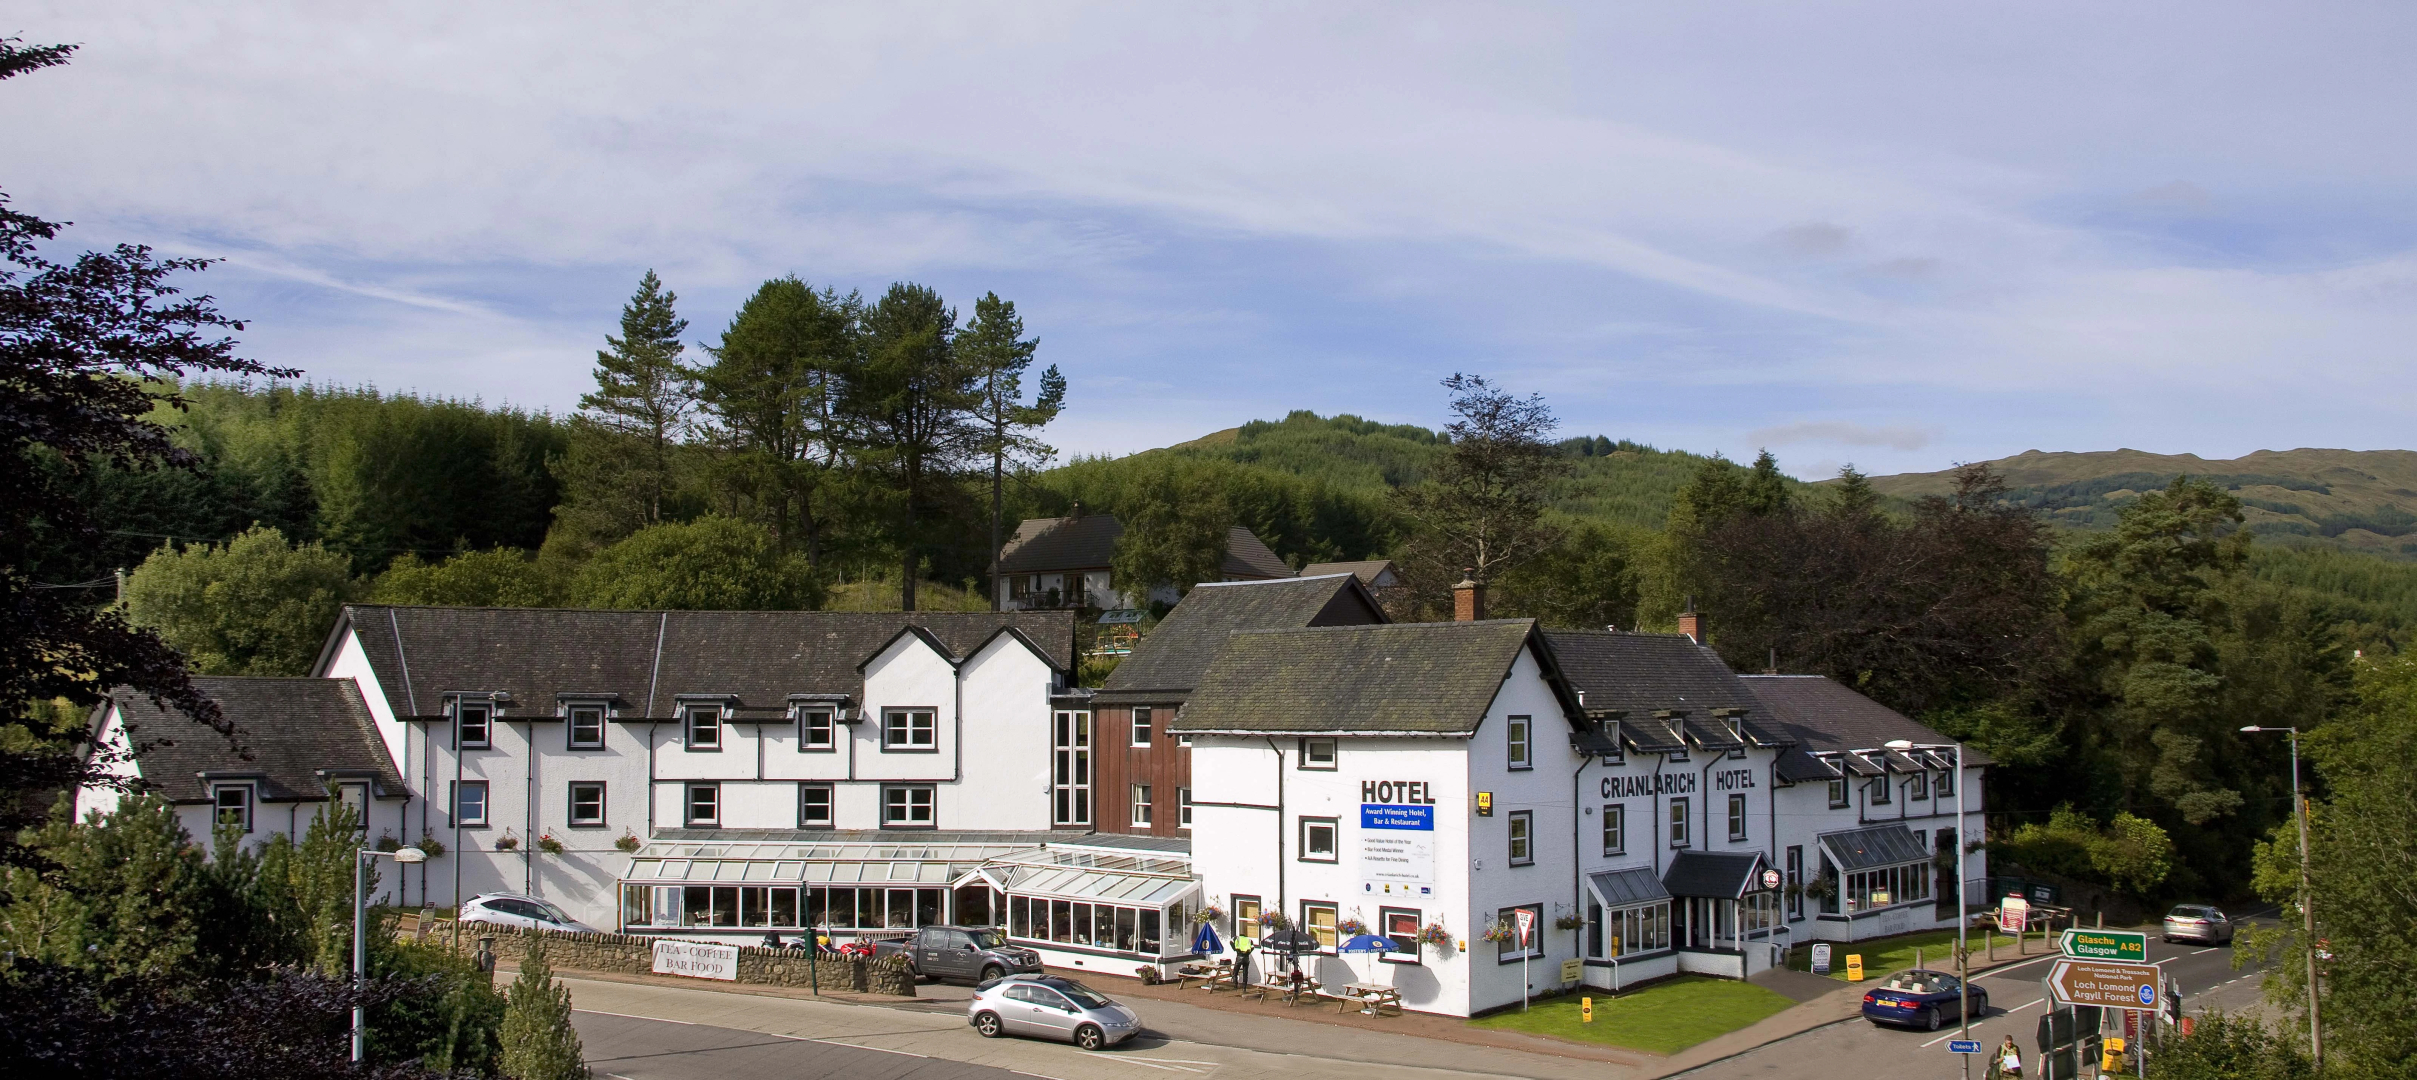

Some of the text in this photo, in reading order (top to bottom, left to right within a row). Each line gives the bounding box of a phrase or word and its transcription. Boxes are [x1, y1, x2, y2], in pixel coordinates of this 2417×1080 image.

[1601, 769, 1755, 799] CRIANLARICH HOTEL
[1361, 780, 1436, 804] HOTEL
[1384, 808, 1408, 818] Winning
[1408, 809, 1427, 817] Hotel,
[1390, 818, 1420, 826] Restaurant
[2077, 934, 2115, 945] Glaschu
[660, 943, 681, 955] TEA
[689, 946, 733, 960] COFFEE
[2077, 944, 2118, 956] Glasgow
[666, 958, 723, 974] BAR FOOD
[2091, 966, 2115, 974] Lomond
[2121, 968, 2150, 976] Trossachs
[2093, 972, 2119, 980] National
[2074, 980, 2135, 993] Loch Lomond
[2074, 989, 2136, 1003] Argyll Forest
